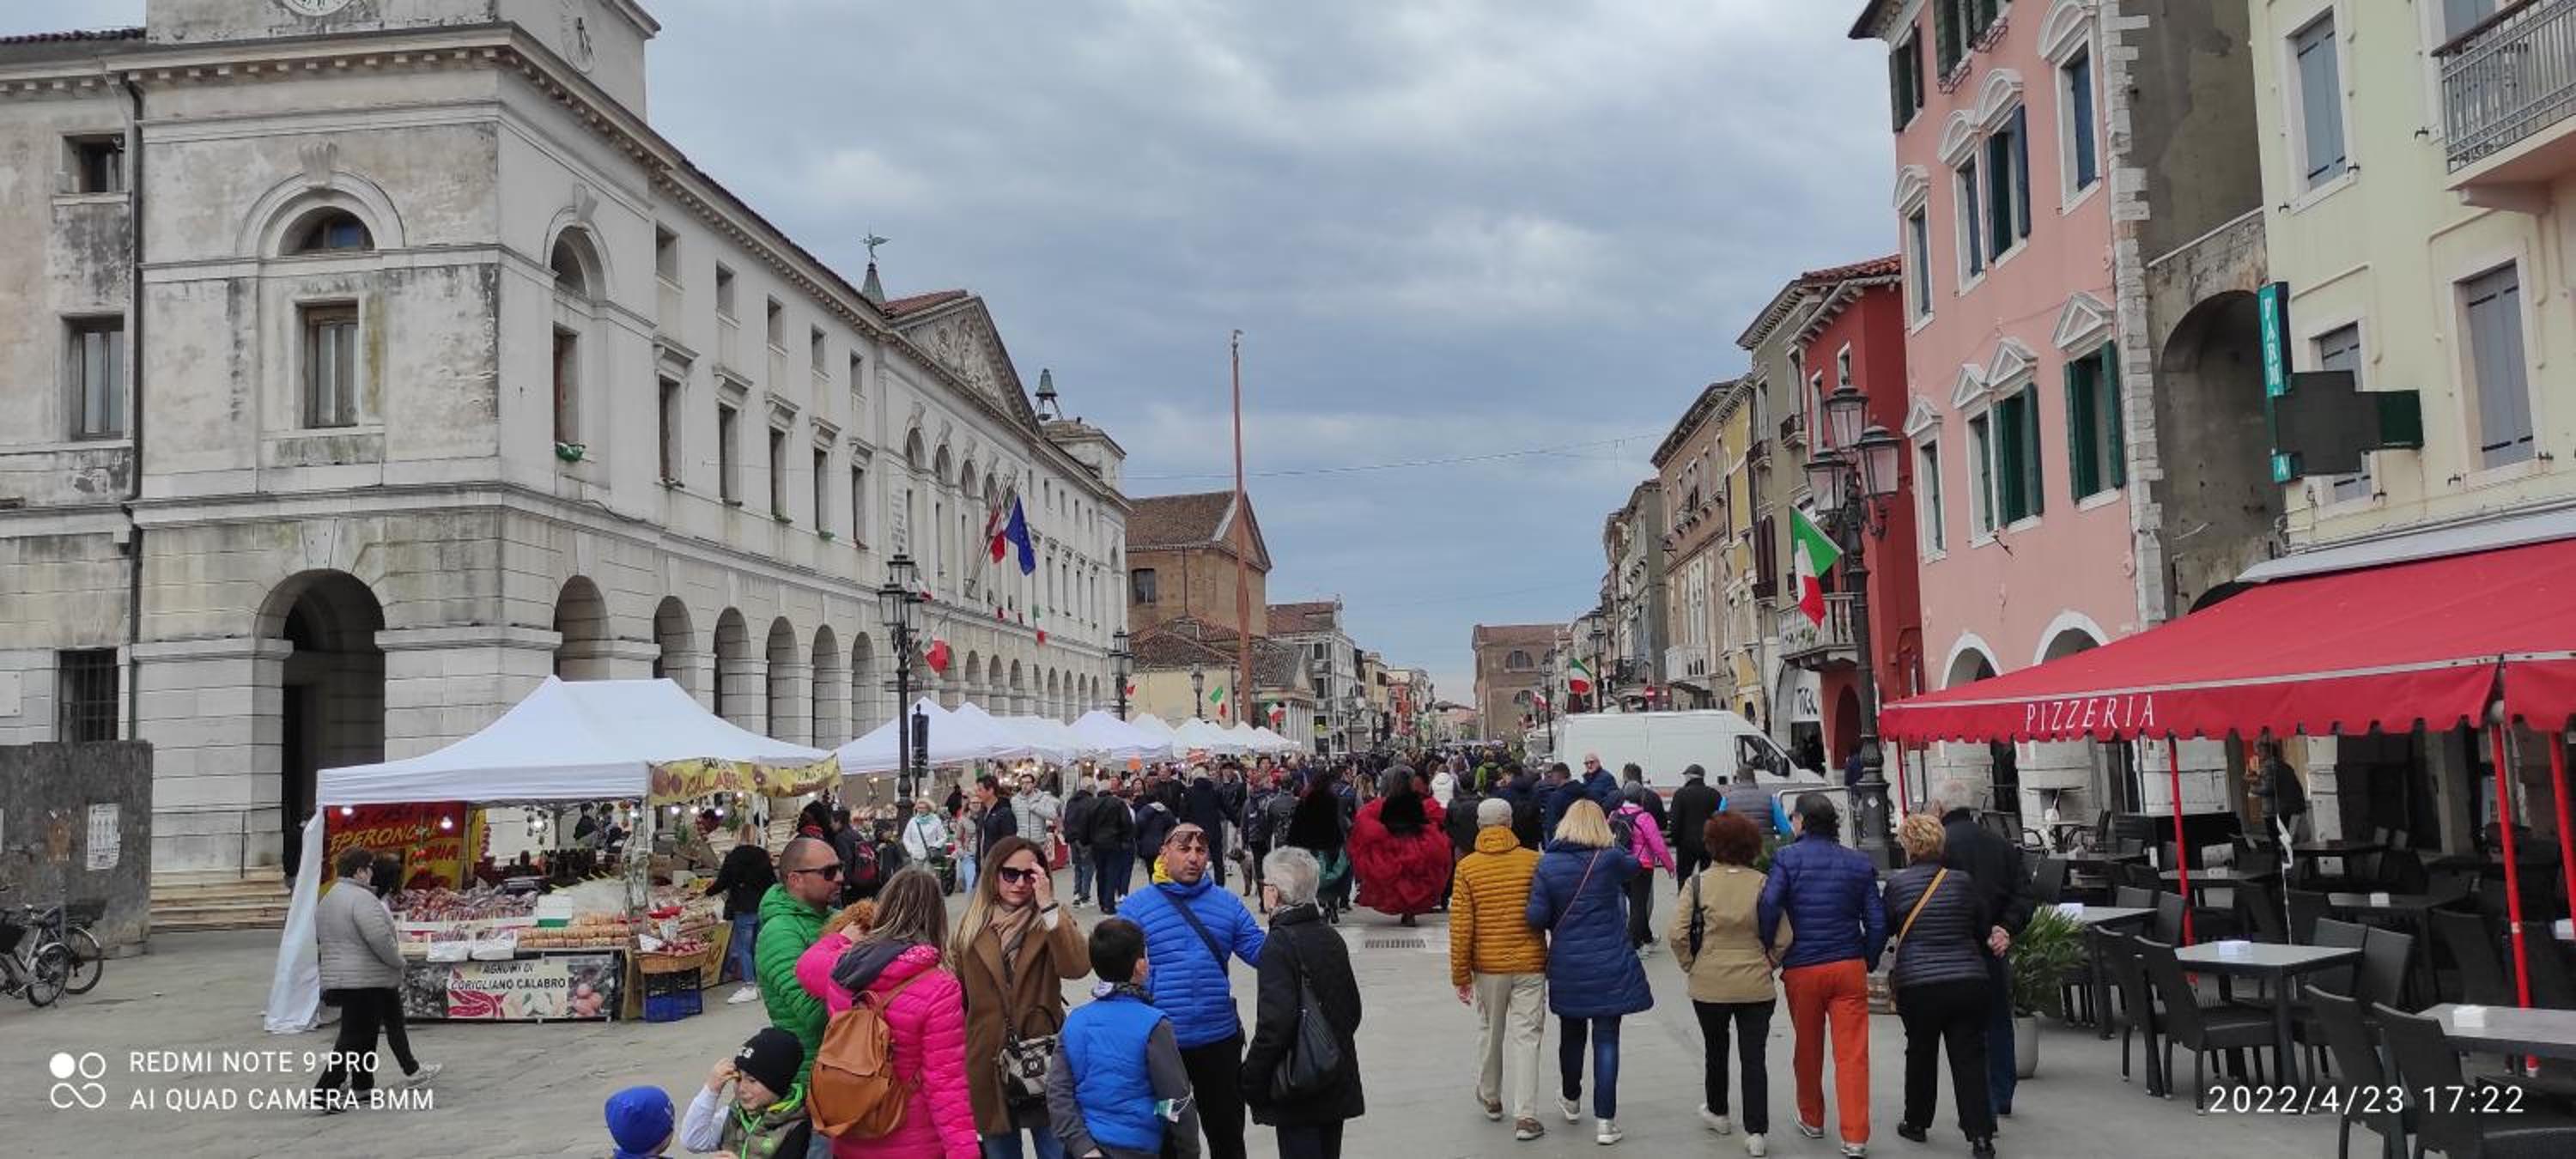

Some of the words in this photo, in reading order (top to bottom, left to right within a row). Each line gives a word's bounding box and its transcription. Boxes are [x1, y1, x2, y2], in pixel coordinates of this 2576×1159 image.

[2264, 297, 2288, 474] FARMA
[2026, 695, 2154, 731] PIZZERIA
[451, 979, 514, 990] CORIGLIANO
[516, 978, 566, 990] CALABRO
